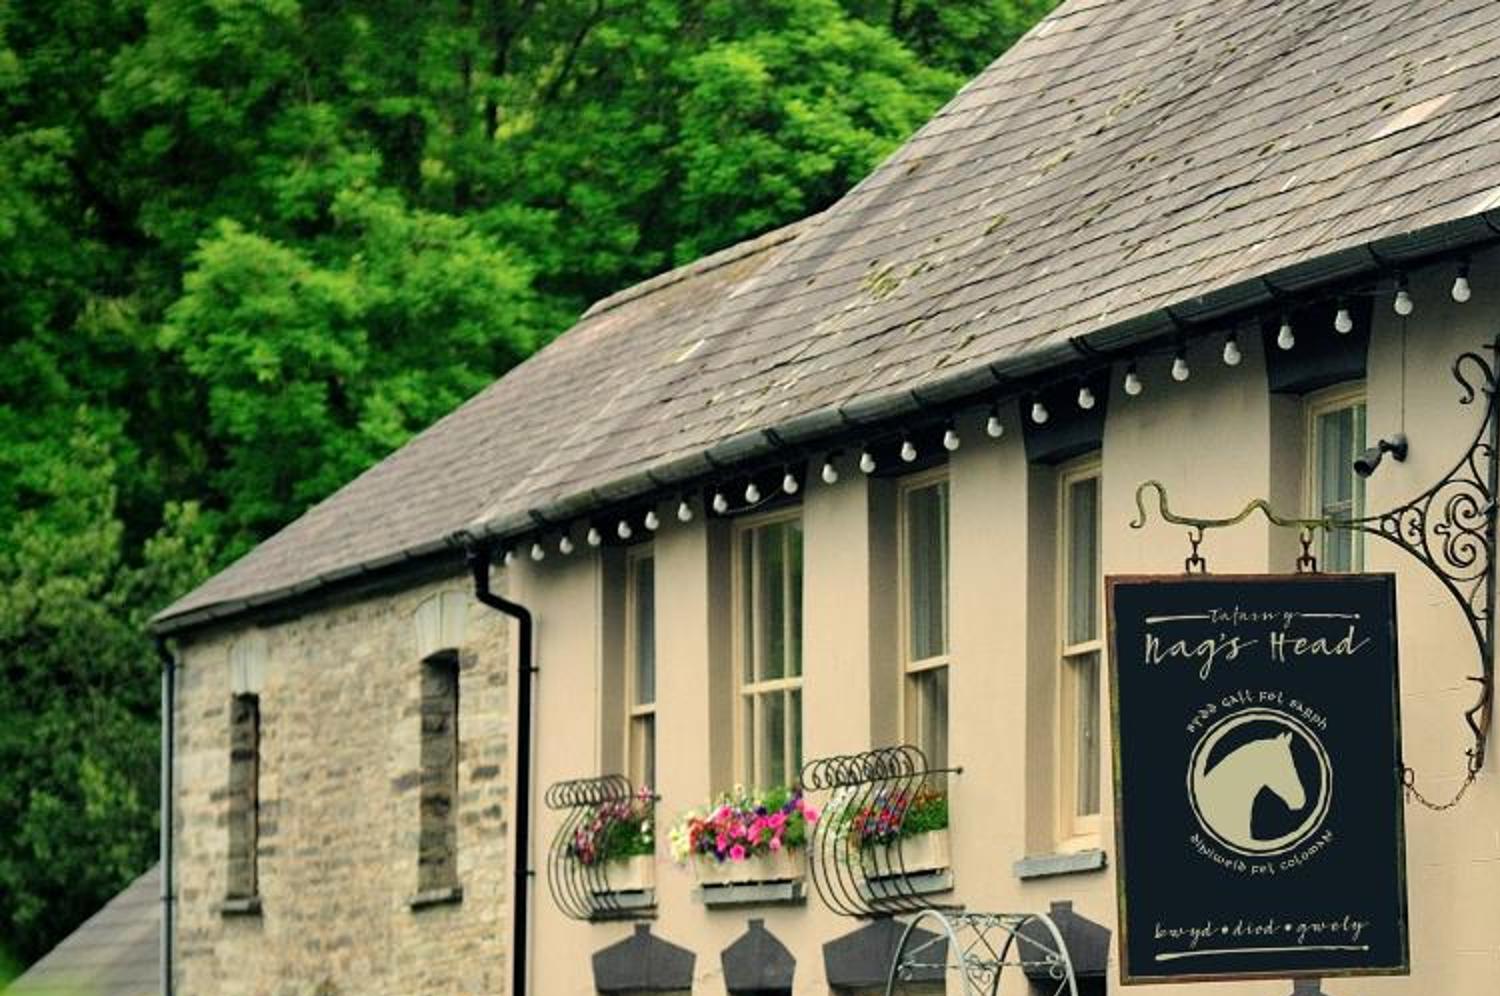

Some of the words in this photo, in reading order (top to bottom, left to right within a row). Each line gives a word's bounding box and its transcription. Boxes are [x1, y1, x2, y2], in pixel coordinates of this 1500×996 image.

[1208, 604, 1278, 625] Tafarn
[1145, 632, 1259, 680] Nag's
[1270, 625, 1371, 662] Head
[1295, 914, 1370, 944] gwely
